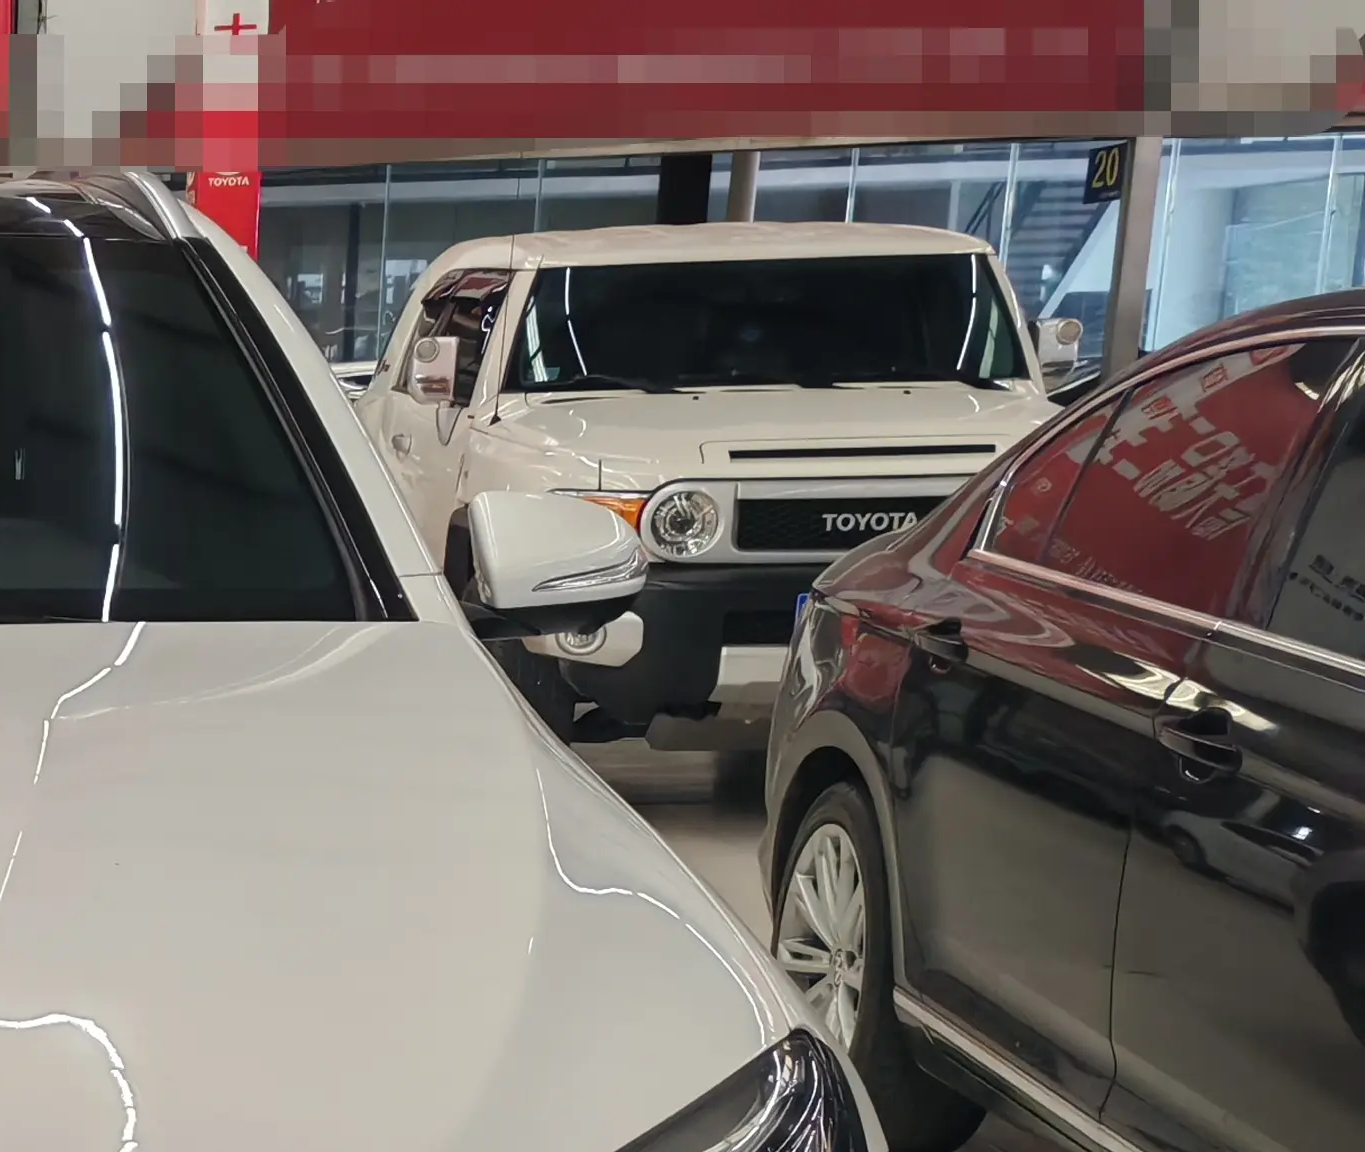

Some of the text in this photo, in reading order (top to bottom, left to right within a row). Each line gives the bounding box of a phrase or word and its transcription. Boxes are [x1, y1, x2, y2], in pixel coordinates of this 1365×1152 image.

[1092, 147, 1120, 189] 20
[208, 176, 250, 187] TOYOTA
[822, 512, 919, 532] TOYOTA
